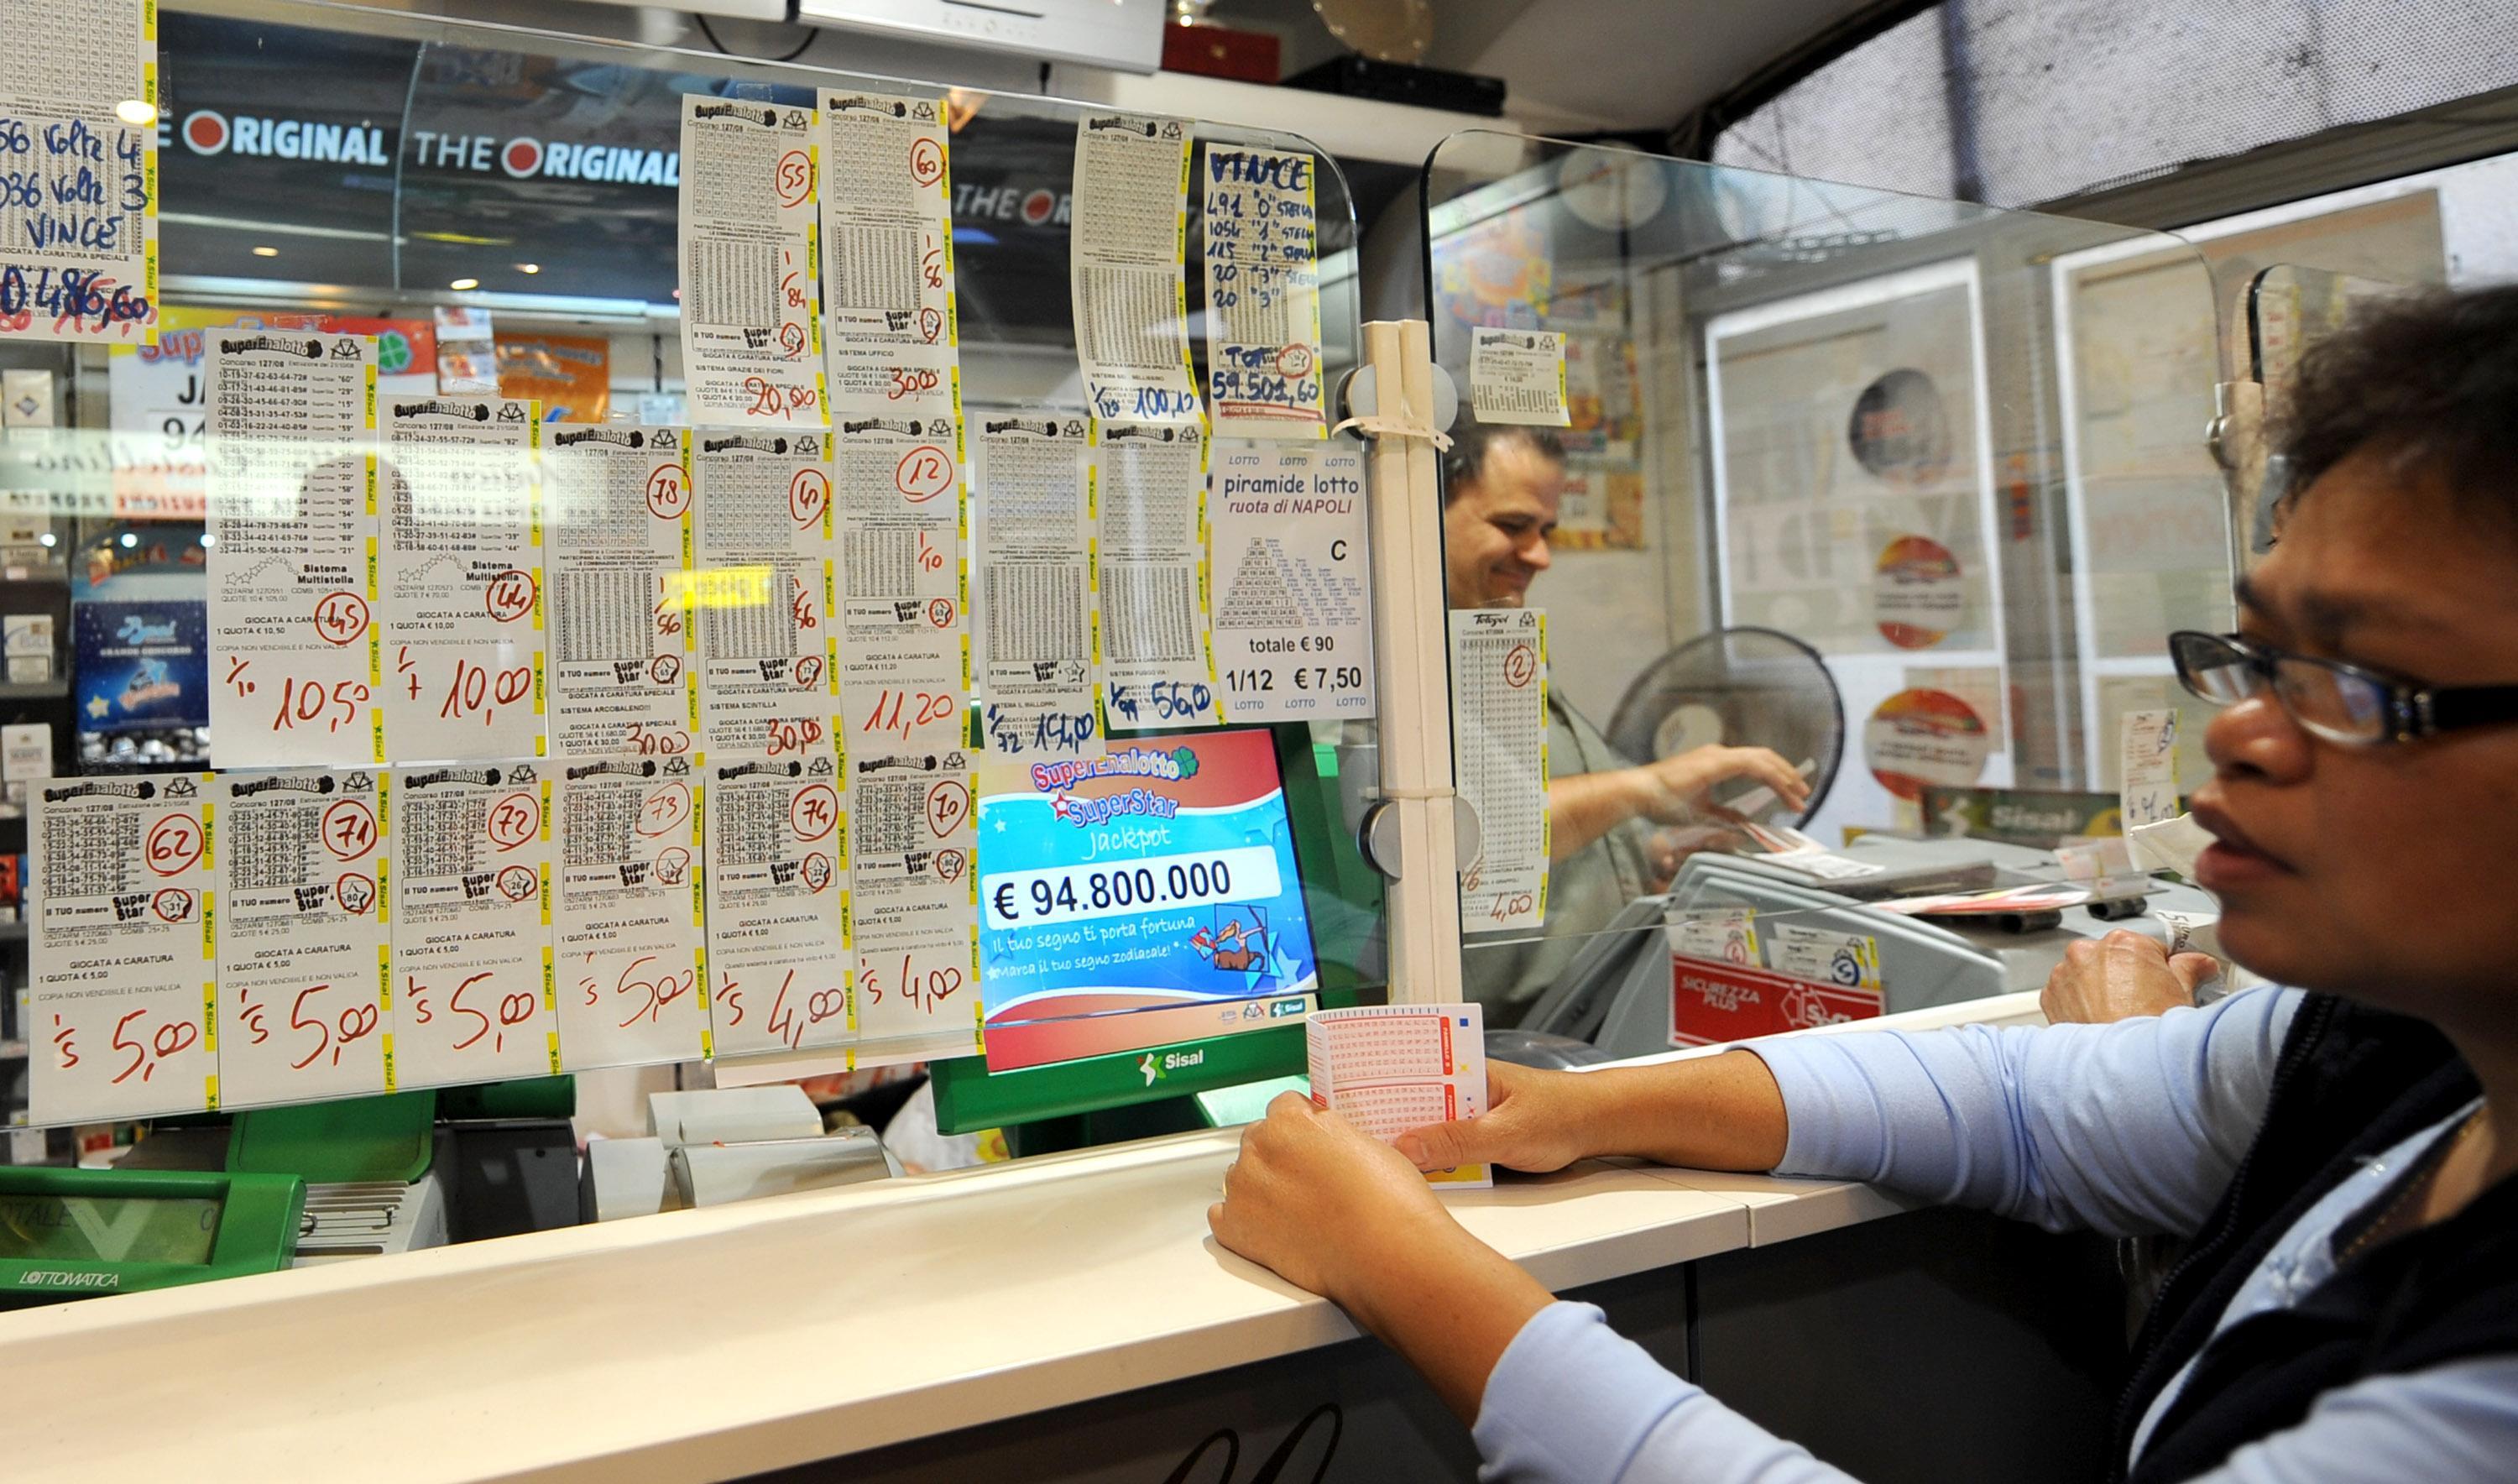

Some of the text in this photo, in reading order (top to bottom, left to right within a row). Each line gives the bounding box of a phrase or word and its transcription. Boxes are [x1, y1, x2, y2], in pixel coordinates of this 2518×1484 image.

[117, 128, 138, 169] 4
[415, 131, 495, 170] THE
[1210, 152, 1313, 192] VINCE
[120, 174, 149, 211] 3
[954, 183, 1018, 218] THE
[25, 212, 124, 248] VINCE
[908, 457, 939, 485] 12
[1228, 456, 1356, 468] LOTTO LOTTO LOTTO
[652, 478, 679, 506] 78
[1225, 473, 1359, 498] piramide lotto
[1229, 498, 1352, 515] ruota di NAPOLI
[1330, 539, 1348, 562] C
[223, 627, 256, 635] QUOTA
[396, 622, 426, 630] QUOTA
[1249, 635, 1335, 654] totale € 90
[613, 660, 645, 674] Super
[759, 658, 788, 671] Super
[762, 669, 784, 682] Star
[617, 671, 640, 685] Star
[1226, 666, 1363, 694] 1/12 € 7,50
[863, 689, 953, 741] 11,20
[1235, 696, 1366, 710] LOTTO LOTTO LOTTO
[1032, 747, 1182, 792] SuperEnalotto
[498, 804, 527, 837] 72
[1067, 789, 1179, 828] SuperStar
[1990, 802, 2082, 832] Sisal
[336, 813, 370, 848] 71
[151, 828, 191, 861] 62
[462, 872, 496, 888] Super
[619, 861, 650, 876] Super
[622, 873, 645, 887] Star
[112, 892, 151, 910] Super
[294, 884, 331, 901] Super
[465, 884, 491, 899] Star
[993, 860, 1231, 920] € 94.800.000
[115, 906, 146, 922] Star
[297, 897, 325, 912] Star
[1007, 936, 1033, 951] tuo
[1037, 933, 1081, 951] segno
[1084, 925, 1097, 942] ti
[1101, 924, 1136, 945] porta
[1141, 916, 1196, 938] fortuna
[123, 954, 175, 966] CARATURA
[1052, 959, 1071, 972] tuo
[1074, 954, 1110, 971] segno
[1112, 943, 1172, 963] zodiacale!
[46, 972, 80, 983] QUOTA
[901, 954, 962, 1015] 4,00
[1681, 975, 1761, 1004] SICUREZZA
[450, 972, 535, 1053] 5,00
[767, 968, 845, 1050] 4,00
[1702, 992, 1738, 1012] PLUS
[290, 984, 379, 1071] 5,00
[111, 1009, 199, 1084] 5,00
[1164, 1048, 1204, 1070] Sisal
[19, 1270, 119, 1288] LOTTOMATICA
